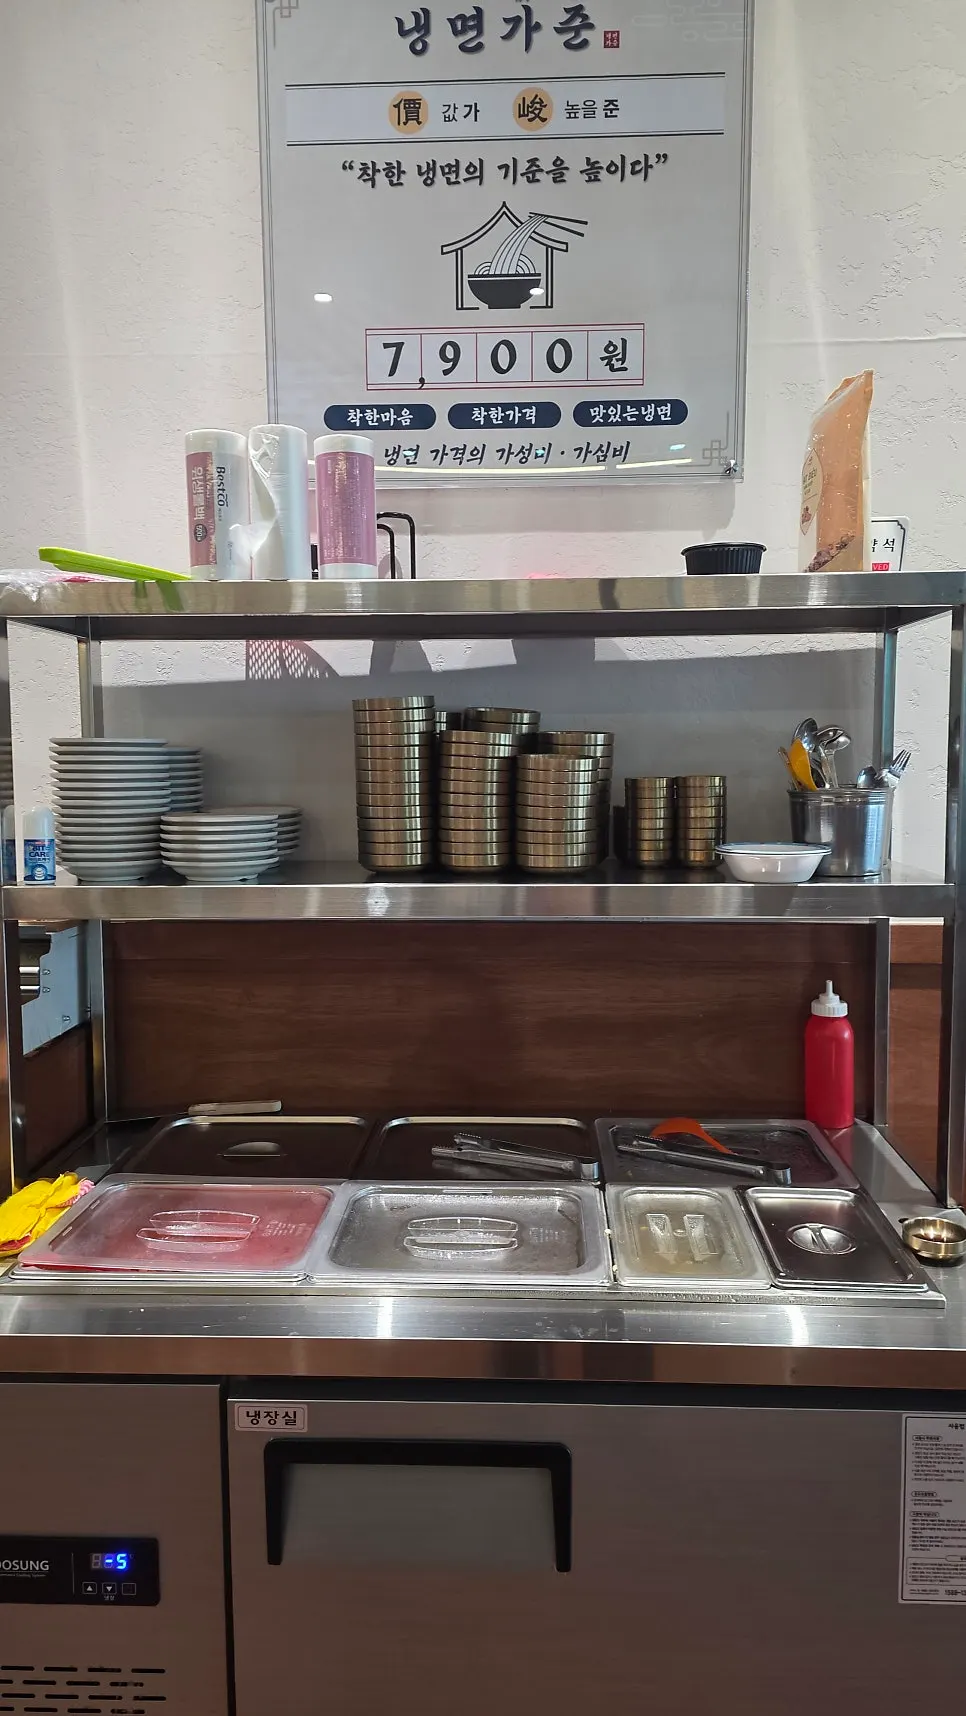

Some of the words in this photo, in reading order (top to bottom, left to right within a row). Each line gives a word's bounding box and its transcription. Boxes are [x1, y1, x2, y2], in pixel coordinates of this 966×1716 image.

[395, 4, 595, 56] 냉면가준
[392, 97, 423, 127] 價
[442, 103, 458, 122] 값
[463, 103, 480, 122] 가
[517, 94, 548, 124] 峻
[565, 100, 597, 119] 높을
[603, 100, 619, 118] 준
[417, 158, 483, 186] 냉면의
[498, 156, 569, 185] 기준을
[382, 337, 629, 390] 7,900원
[347, 407, 414, 428] 착한마음
[471, 406, 538, 426] 착한가격
[590, 403, 671, 423] 맛있는냉면
[430, 444, 486, 465] 가격의
[496, 443, 552, 464] 가성비
[574, 441, 630, 463] 가심비
[216, 466, 228, 507] Bestco
[246, 1410, 297, 1426] 냉장실
[0, 1560, 50, 1571] OSUNG
[105, 1553, 127, 1569] -5
